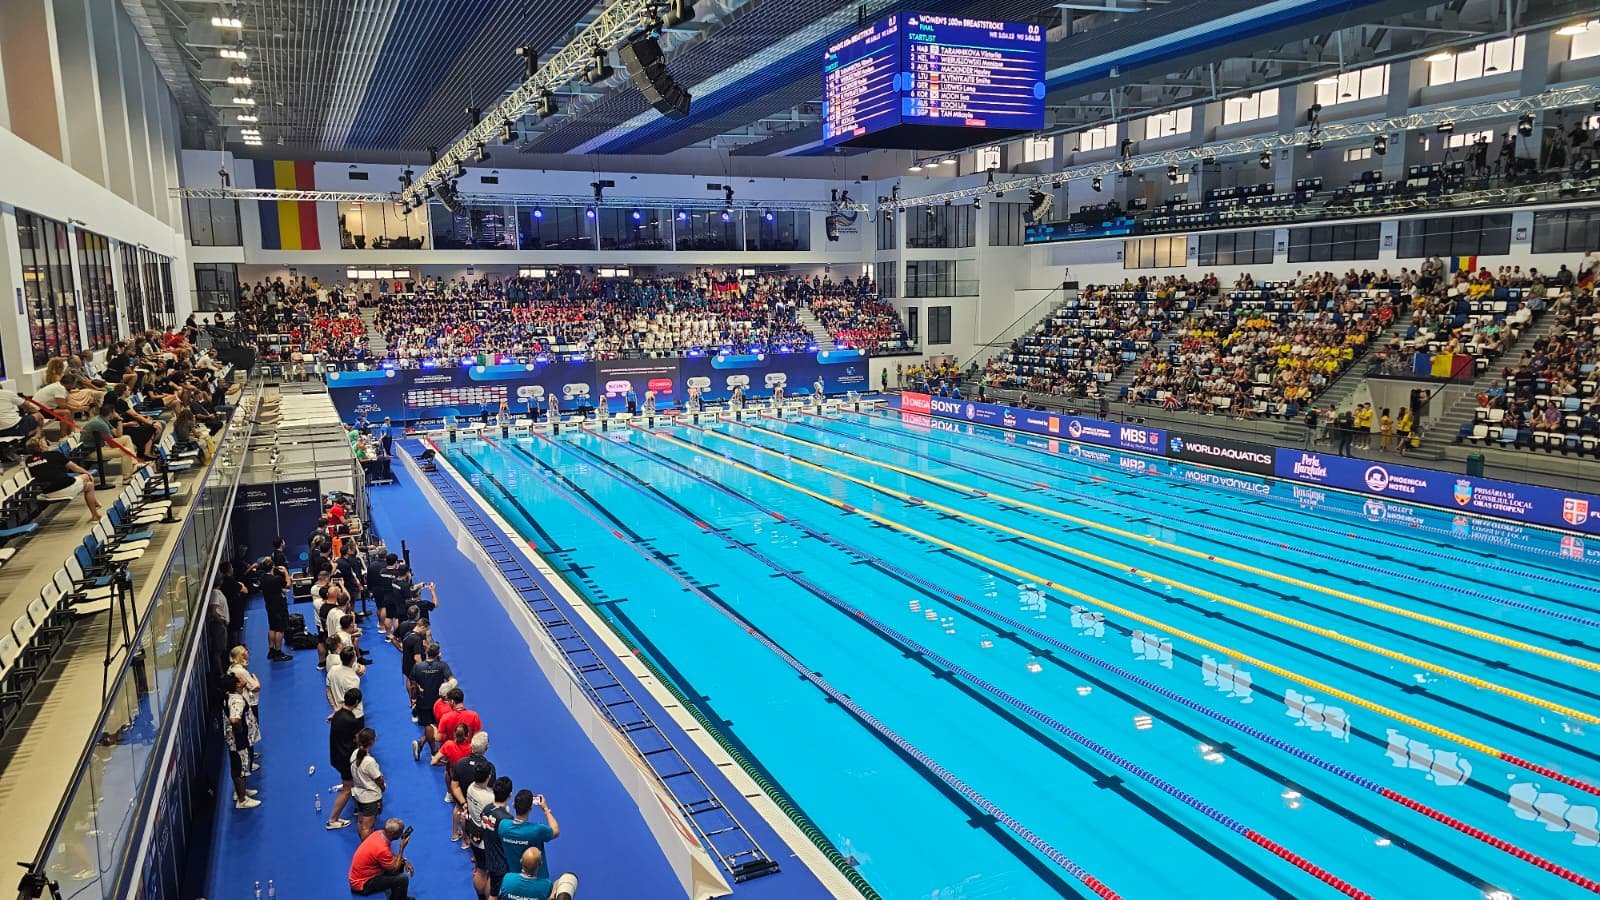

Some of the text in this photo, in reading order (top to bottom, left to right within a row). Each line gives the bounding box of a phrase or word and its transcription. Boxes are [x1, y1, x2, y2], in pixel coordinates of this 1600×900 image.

[931, 400, 961, 414] SONY
[1120, 428, 1146, 444] MBS
[1186, 442, 1272, 465] WORLD AQUATICS
[1389, 483, 1415, 493] HOTELS
[1390, 476, 1427, 488] PHOENICIA
[1474, 494, 1533, 509] CONSILIUL LOCAL
[1493, 504, 1524, 514] OTOPENI
